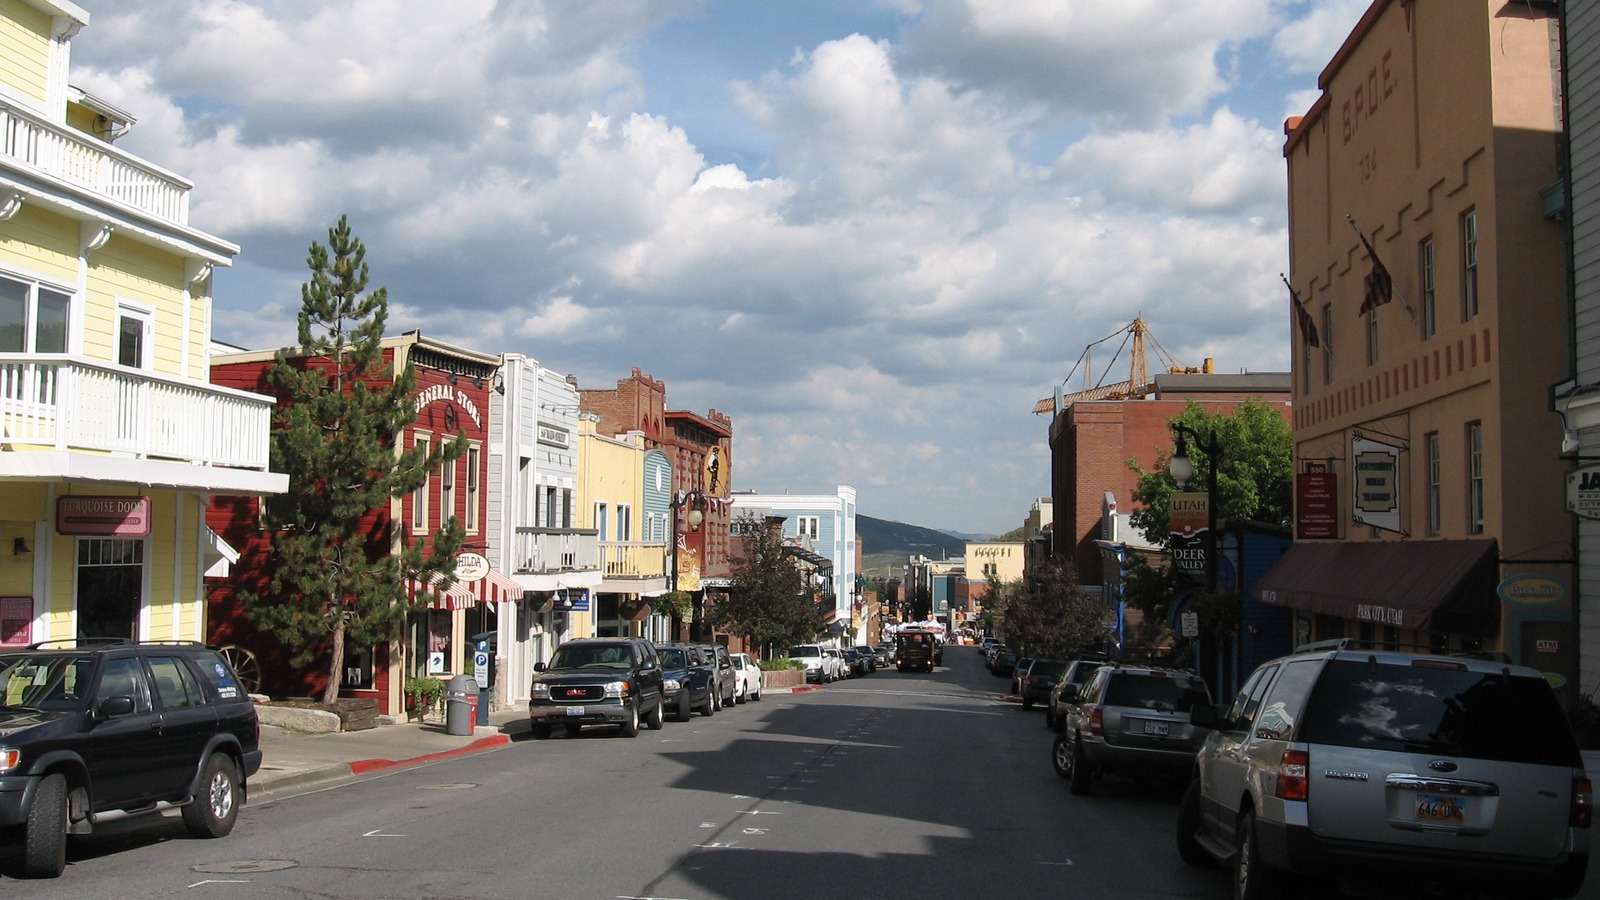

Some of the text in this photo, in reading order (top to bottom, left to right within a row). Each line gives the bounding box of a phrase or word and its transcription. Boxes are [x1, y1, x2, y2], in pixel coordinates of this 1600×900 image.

[414, 384, 454, 414] GENERAL
[63, 500, 144, 514] TURQUOISE DOOR
[1173, 500, 1206, 511] UTAH
[1173, 548, 1206, 560] DEER
[1175, 560, 1206, 569] VALLEY
[1356, 603, 1371, 620] PARK
[480, 640, 487, 650] P
[1538, 641, 1558, 649] ATM
[478, 655, 486, 665] P
[1418, 802, 1437, 817] 646
